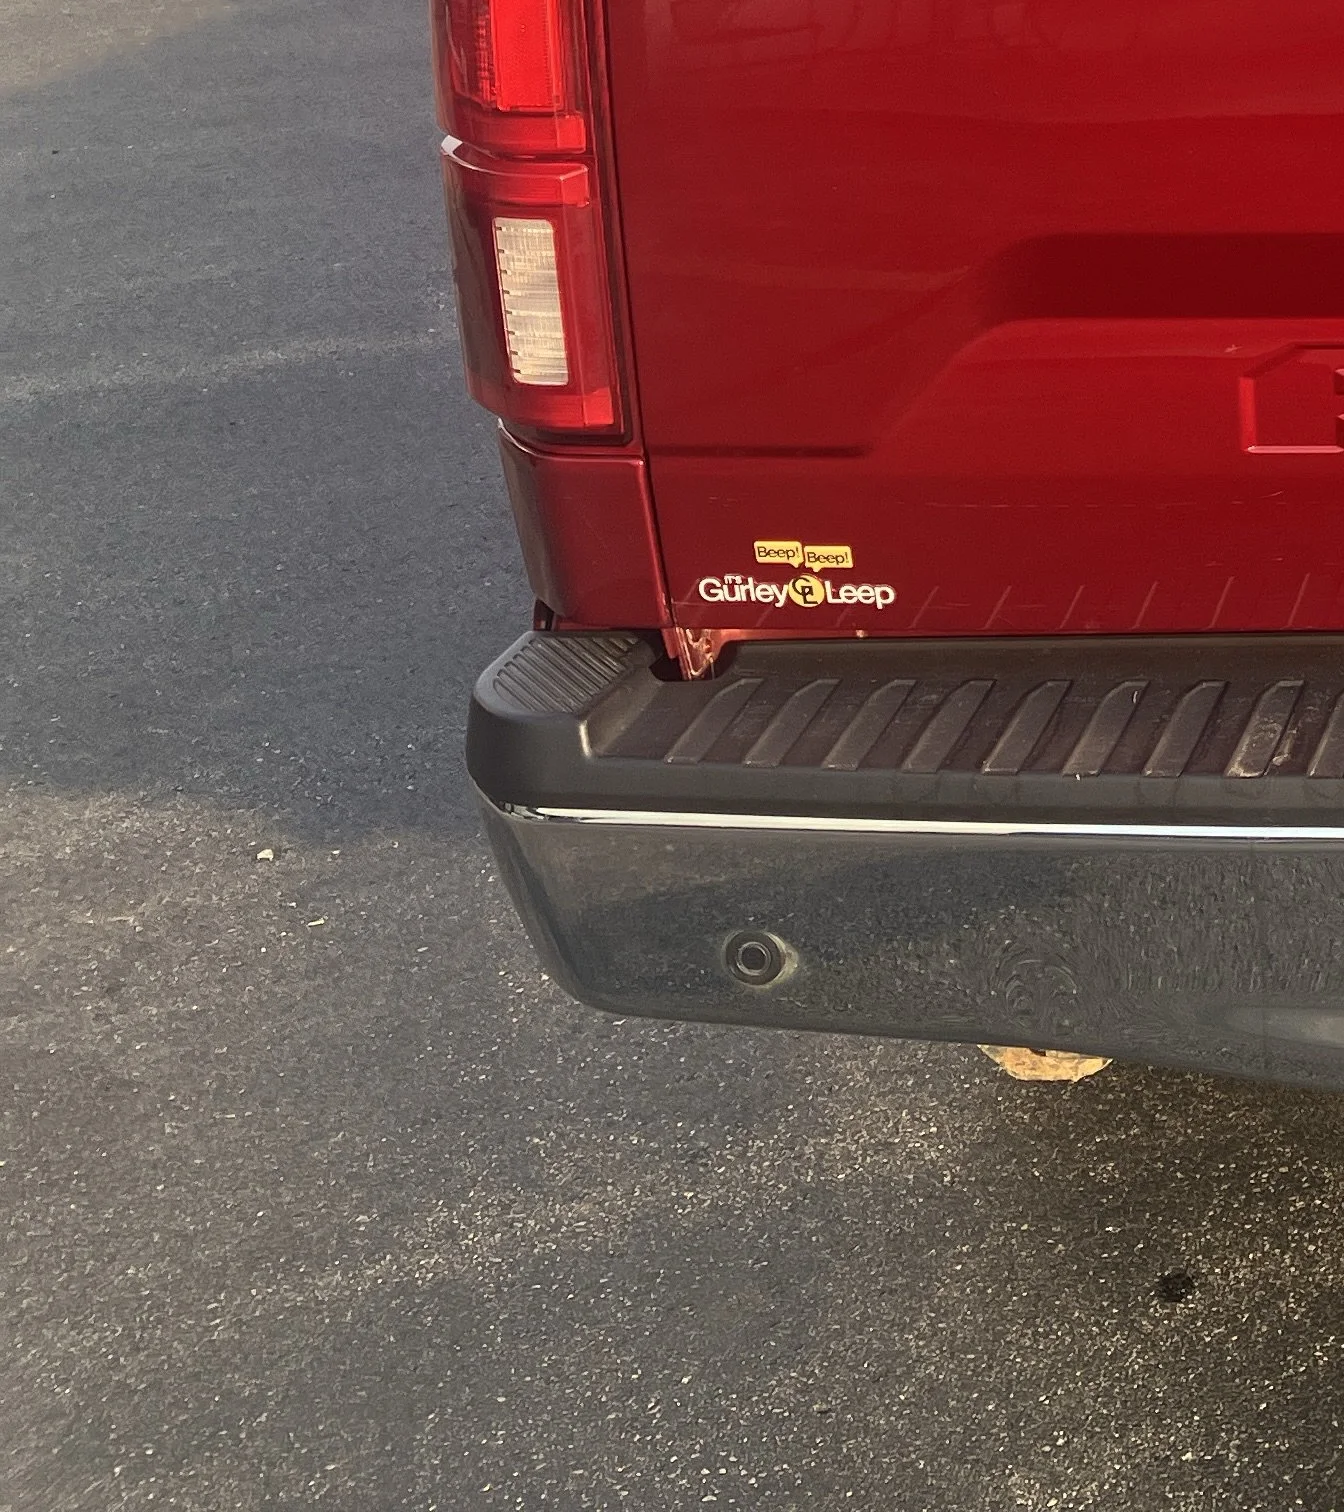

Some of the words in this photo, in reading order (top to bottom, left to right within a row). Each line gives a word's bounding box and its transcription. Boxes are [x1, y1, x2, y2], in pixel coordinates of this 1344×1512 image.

[757, 546, 800, 559] Beep!
[806, 551, 850, 565] Beep!
[825, 580, 895, 609] Leep
